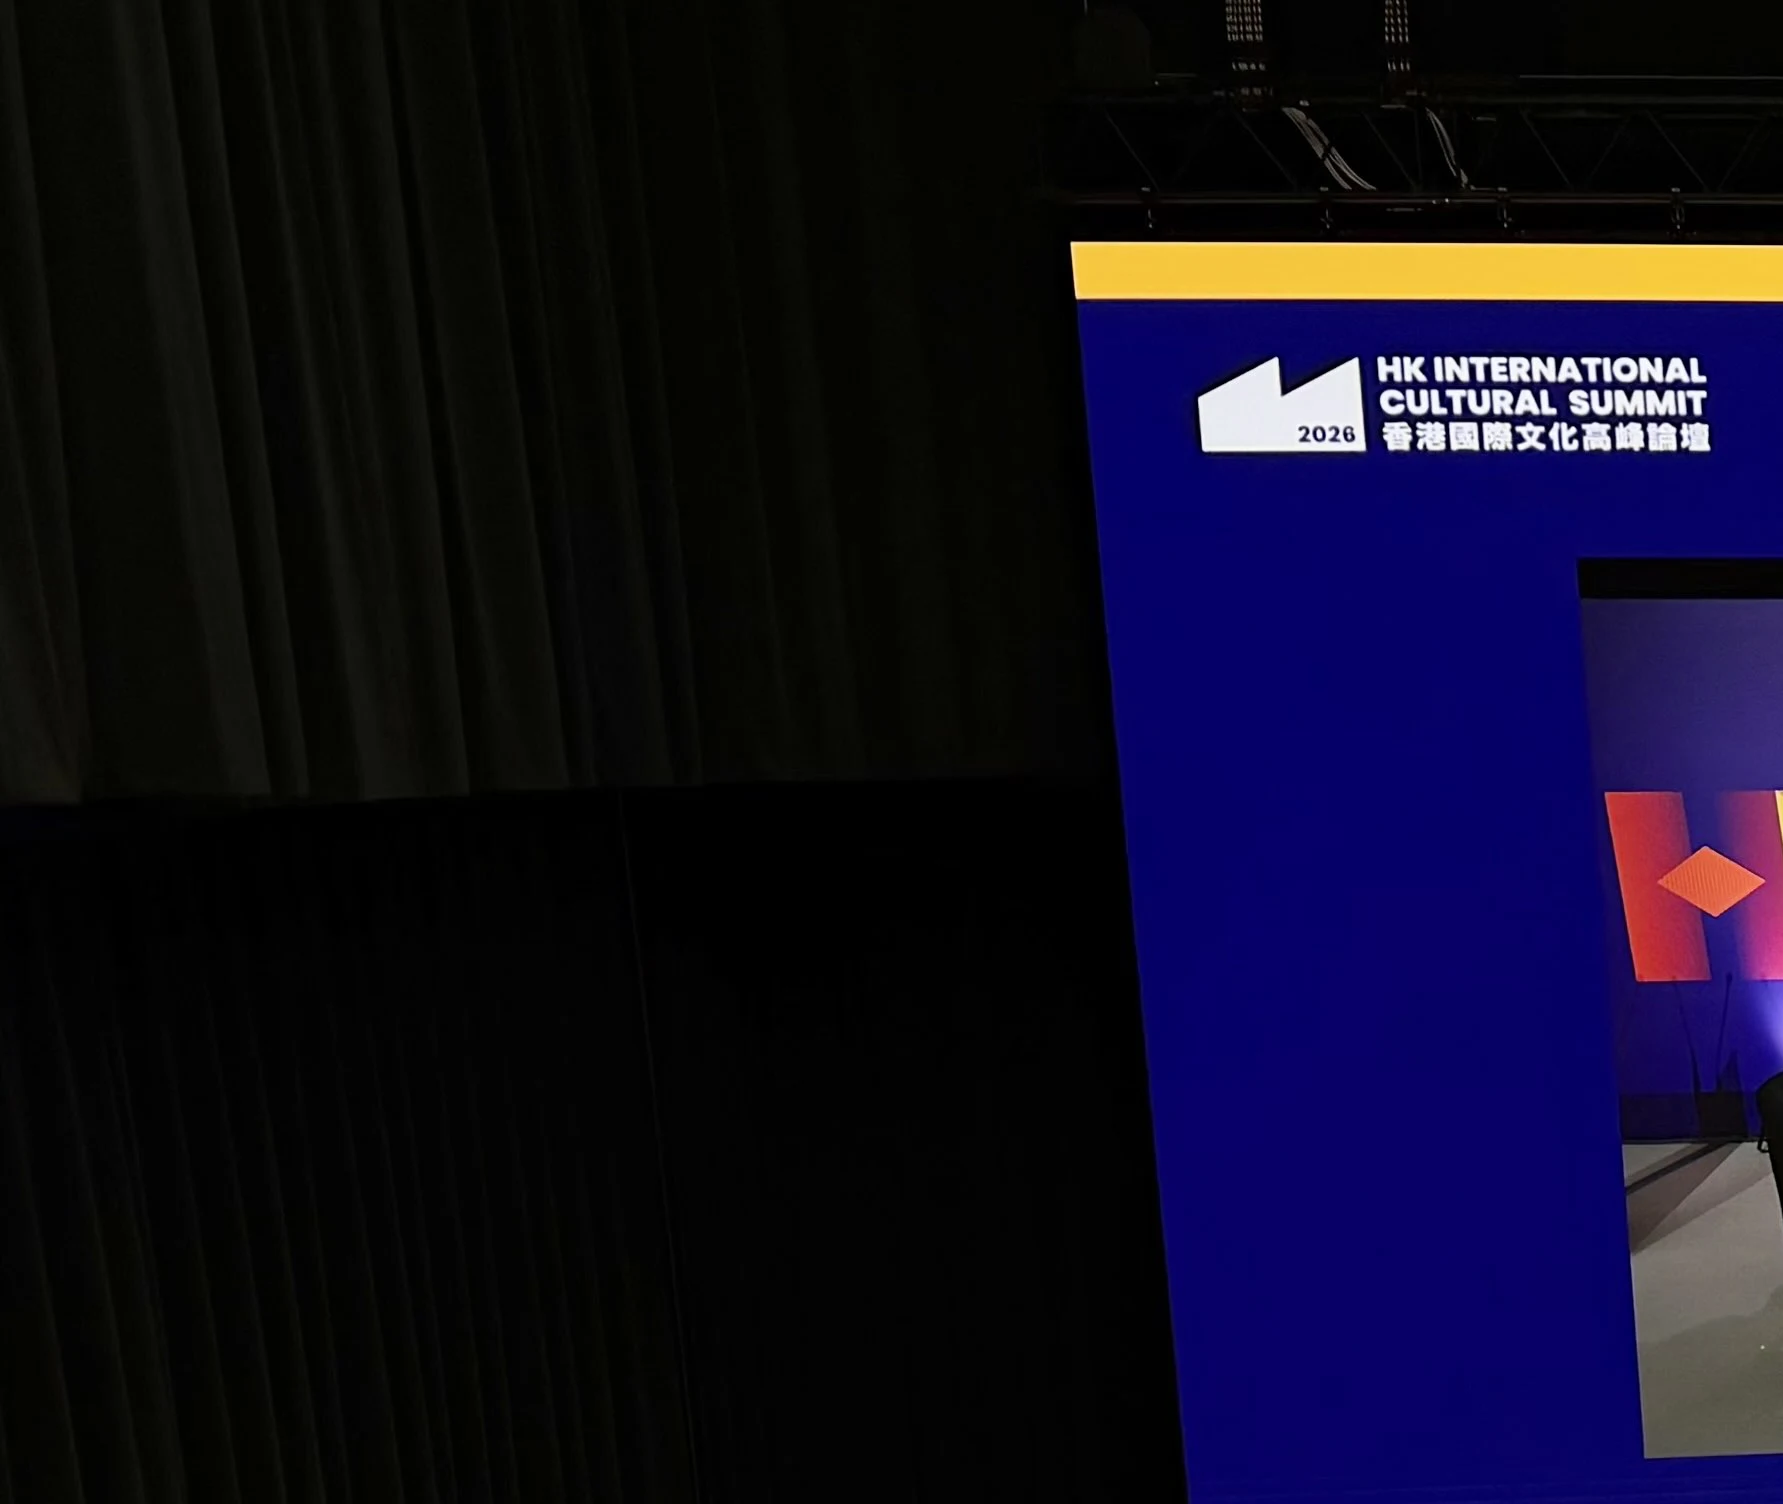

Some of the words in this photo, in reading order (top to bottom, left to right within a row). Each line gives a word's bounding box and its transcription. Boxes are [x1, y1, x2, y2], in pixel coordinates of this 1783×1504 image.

[1377, 357, 1427, 382] HK
[1434, 357, 1706, 383] INTERNATIONAL
[1380, 389, 1557, 415] CULTURAL
[1569, 390, 1707, 415] SUMMIT
[1298, 426, 1355, 442] 2026
[1383, 422, 1710, 451] 香港國際文化高峰論壇
